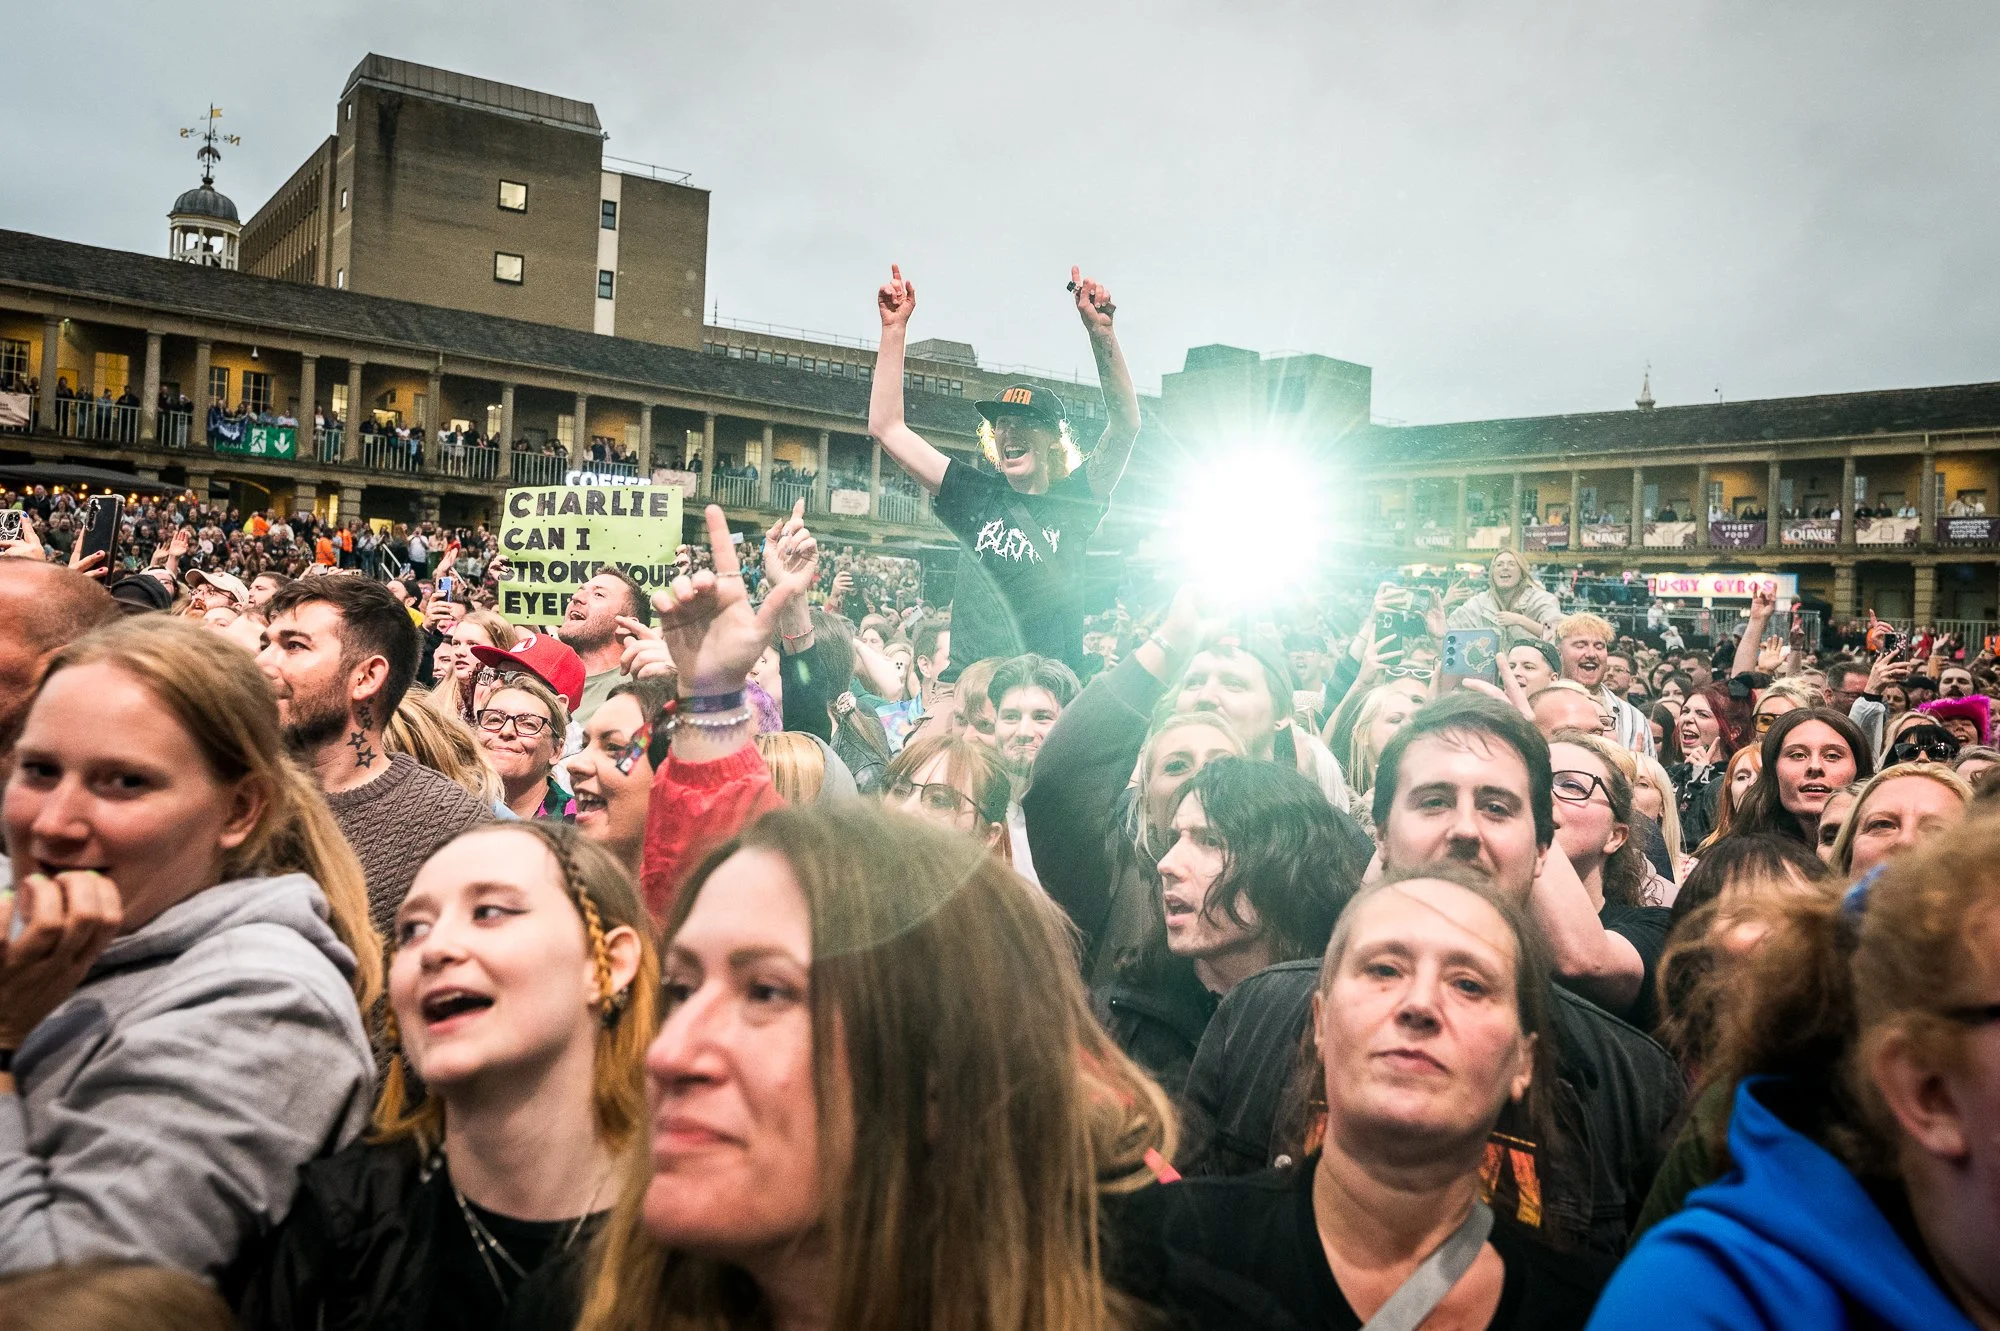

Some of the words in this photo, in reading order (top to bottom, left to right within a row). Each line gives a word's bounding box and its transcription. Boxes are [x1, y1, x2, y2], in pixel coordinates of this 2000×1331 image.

[509, 490, 669, 518] CHARLIE
[504, 528, 565, 550] CAN
[576, 528, 590, 550] I
[1714, 580, 1774, 593] GYROS
